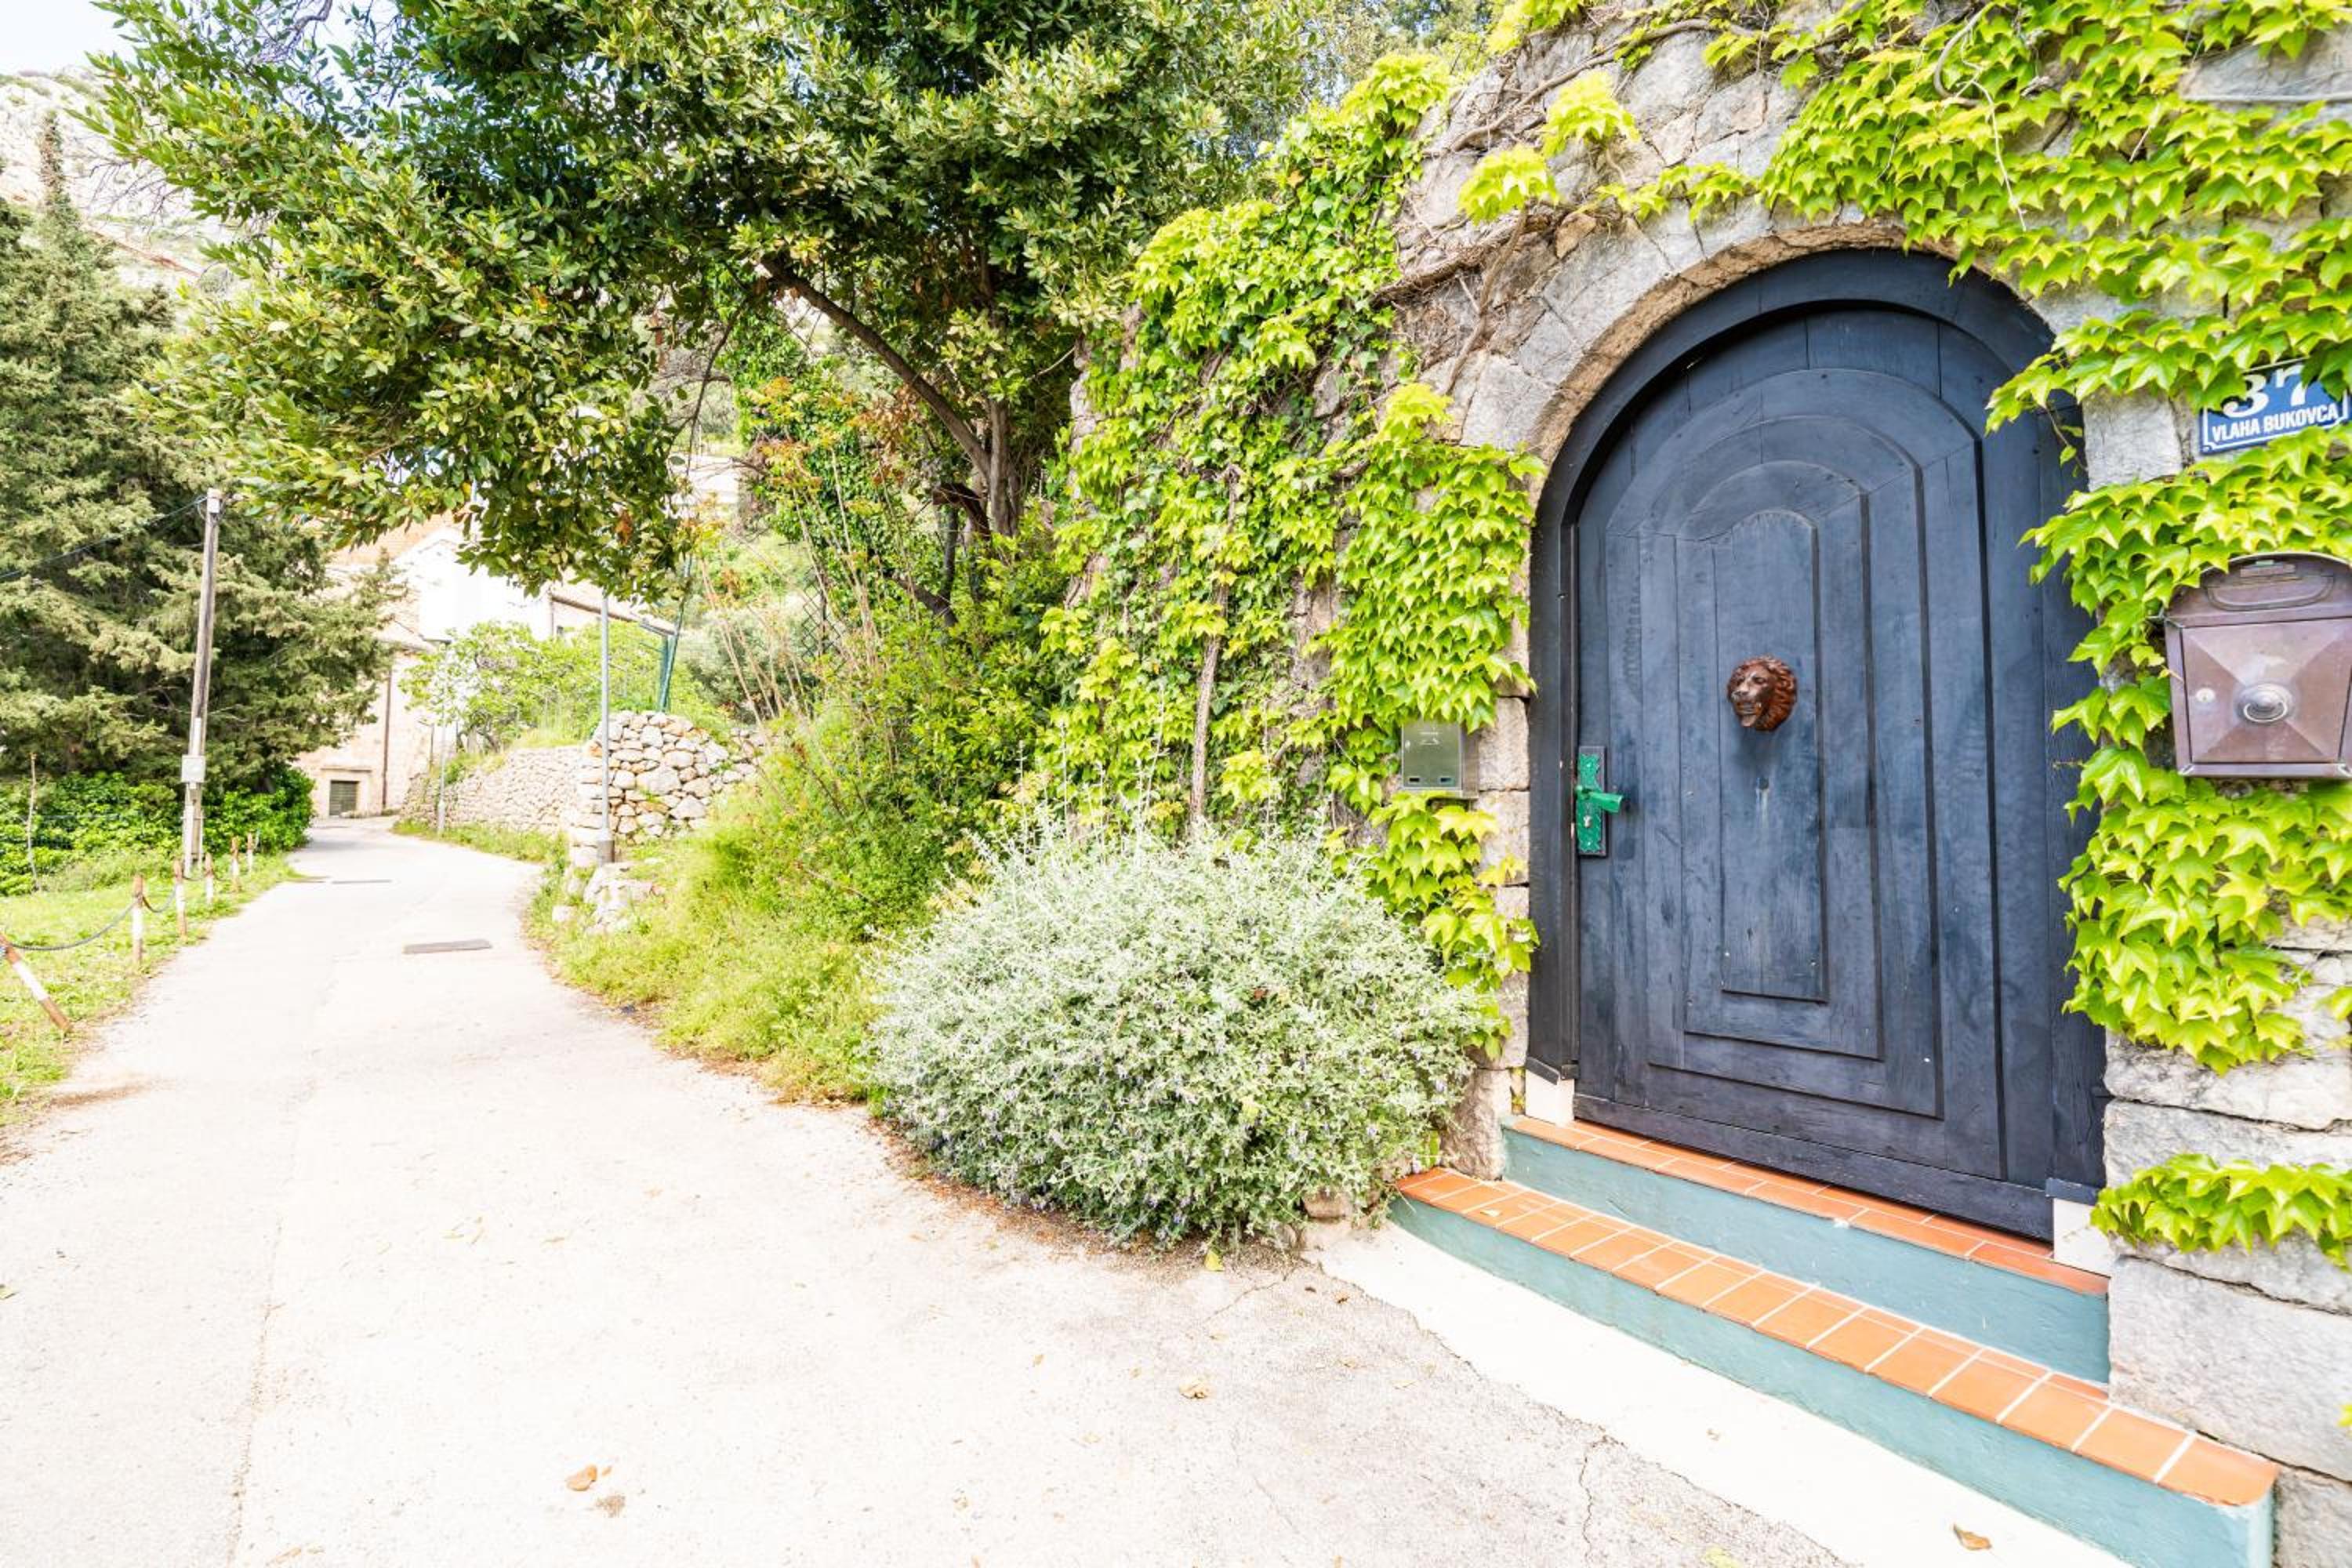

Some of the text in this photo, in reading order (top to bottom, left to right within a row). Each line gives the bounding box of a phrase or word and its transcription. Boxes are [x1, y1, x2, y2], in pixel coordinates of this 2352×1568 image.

[2223, 364, 2307, 418] 37
[2212, 403, 2339, 442] VLAHA BUKOVCA
